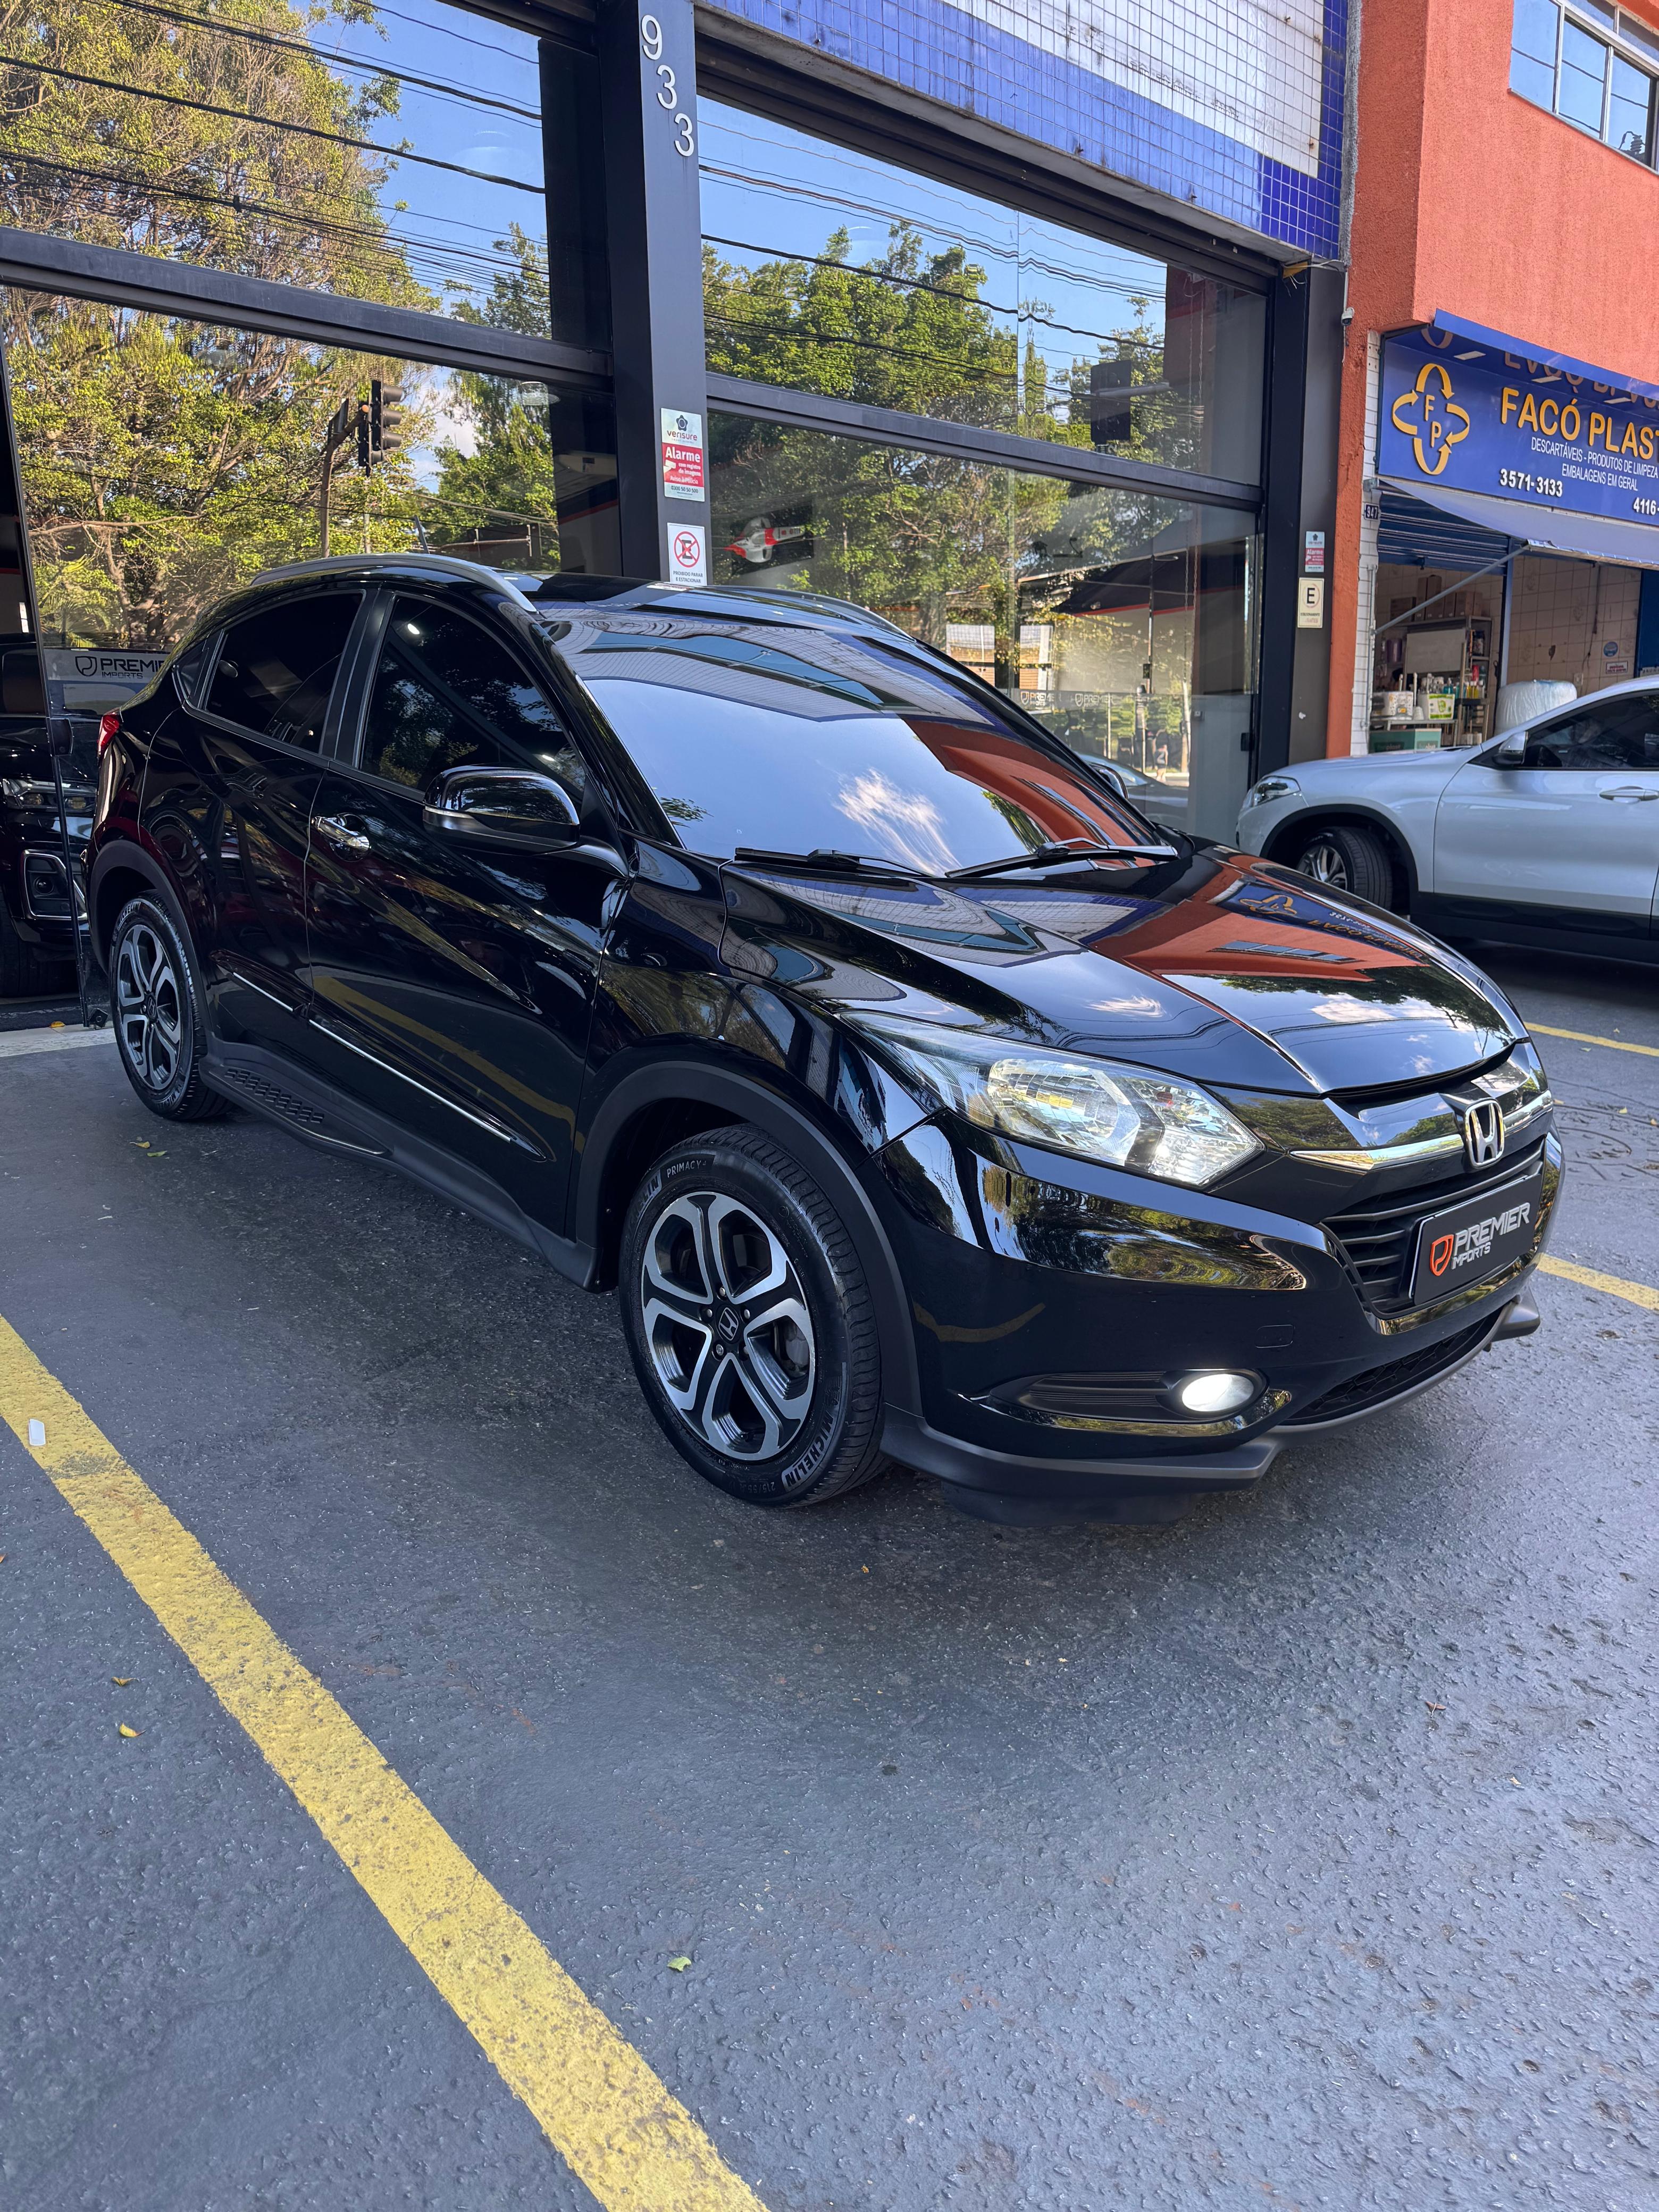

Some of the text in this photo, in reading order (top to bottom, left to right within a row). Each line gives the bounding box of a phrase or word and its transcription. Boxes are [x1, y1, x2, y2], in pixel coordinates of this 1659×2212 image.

[641, 14, 694, 156] 933
[1425, 395, 1435, 421] F
[1501, 387, 1581, 441] FACÓ
[667, 430, 698, 441] verisure
[1431, 421, 1442, 448] P
[665, 447, 701, 463] Alarme
[1531, 437, 1583, 462] DESCARTÁVEIS
[1588, 451, 1622, 471] PRODUTOS
[1624, 459, 1632, 473] DE
[1633, 462, 1658, 479] LIMPEZA
[1500, 468, 1563, 497] 3571-3133
[1562, 463, 1638, 491] EMBALAGENS EM GERAL
[1367, 506, 1377, 518] 947
[1306, 588, 1315, 604] E
[667, 1160, 701, 1178] PRIMACY
[1454, 1202, 1530, 1256] PREMIER
[1451, 1242, 1491, 1269] IMPORTS
[785, 1410, 834, 1487] MICHELIN
